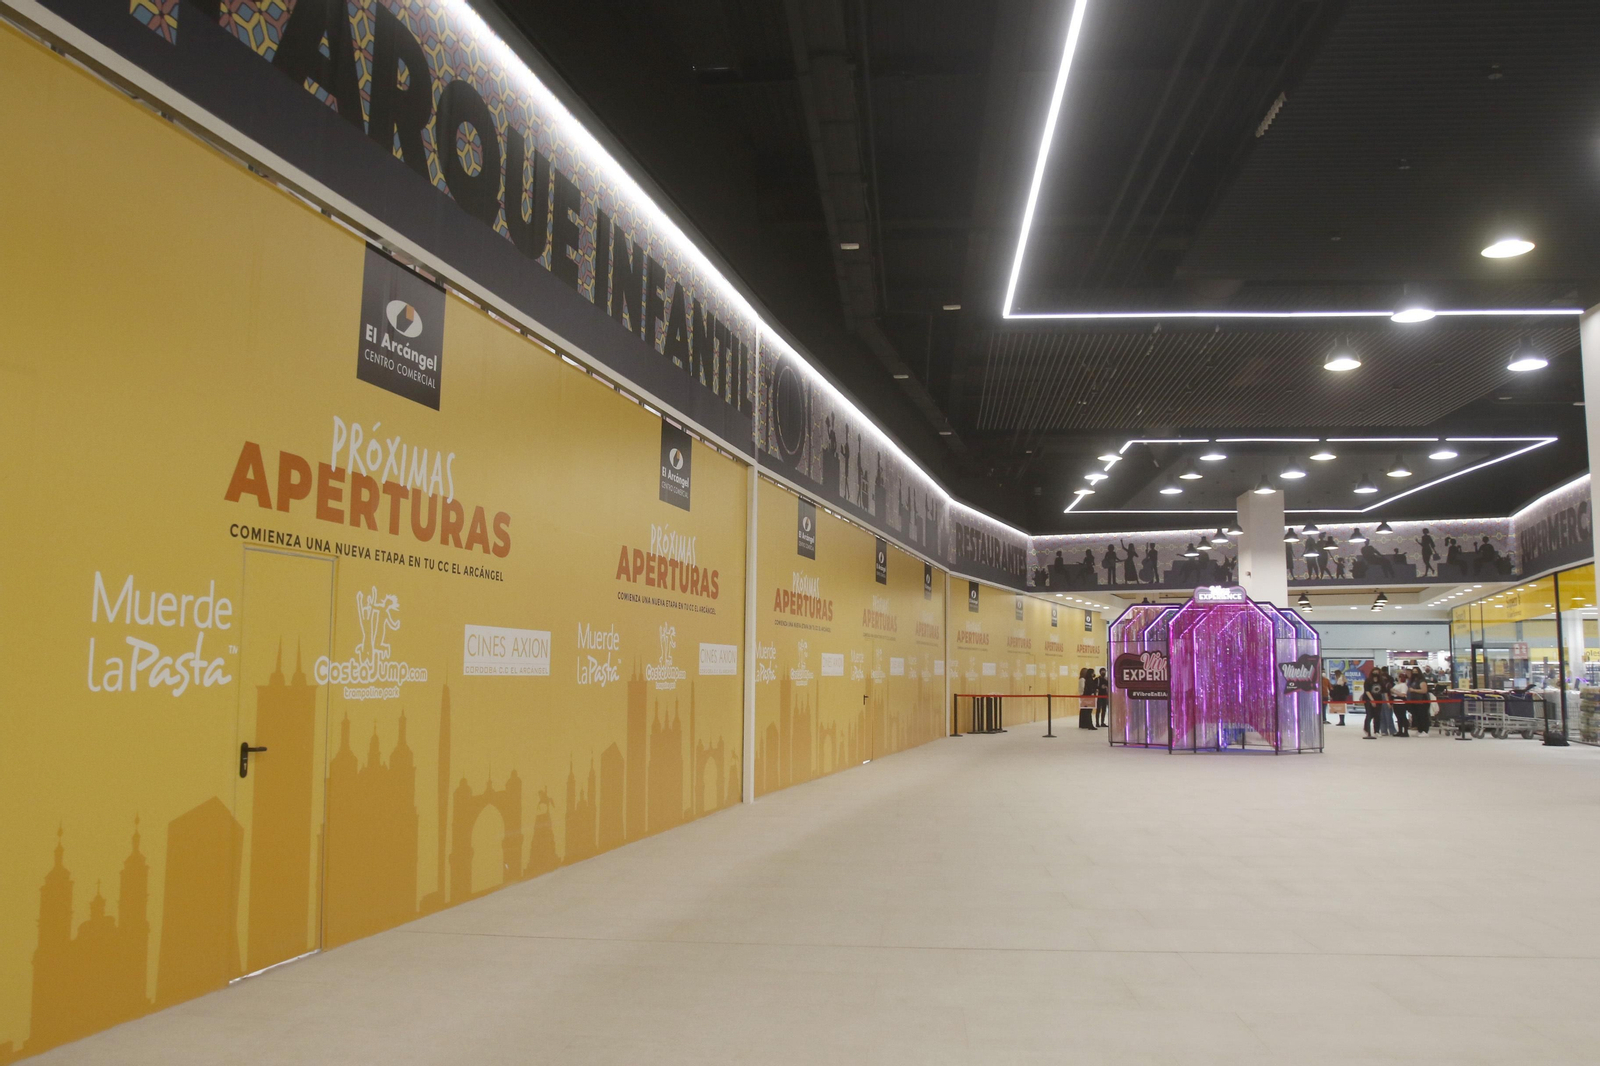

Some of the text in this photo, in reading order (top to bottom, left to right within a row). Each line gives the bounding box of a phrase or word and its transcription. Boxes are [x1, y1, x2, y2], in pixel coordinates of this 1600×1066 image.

[196, 0, 757, 416] ARQUE INFANTIL
[365, 323, 438, 372] El Arcángel
[364, 348, 436, 389] CENTRO COMERCIAL
[330, 415, 455, 504] PRÓXIMAS
[661, 465, 690, 489] El Arcángel
[223, 440, 511, 559] APERTURAS
[651, 523, 697, 569] PRÓXIMAS
[955, 522, 1027, 576] RESTAURANTES
[1521, 501, 1593, 562] SUPERMERC
[229, 523, 504, 582] COMIENZA UNA NUEVA ETAPA EN TU CC EL ARCÁNGEL
[616, 545, 719, 600] APERTURAS
[91, 570, 233, 630] Muerde
[617, 591, 641, 603] COMIENZA
[641, 595, 651, 604] UNA
[651, 597, 665, 607] NUEVA
[665, 600, 678, 608] ETAPA
[678, 602, 684, 610] EN
[773, 587, 834, 622] APERTURAS
[467, 634, 549, 659] CINES AXION
[577, 622, 620, 650] Muerde
[700, 648, 718, 664] CINES
[314, 653, 428, 686] CostaJump.com
[510, 666, 518, 675] EL
[1140, 652, 1168, 671] Viv
[344, 686, 400, 701] trampoline park
